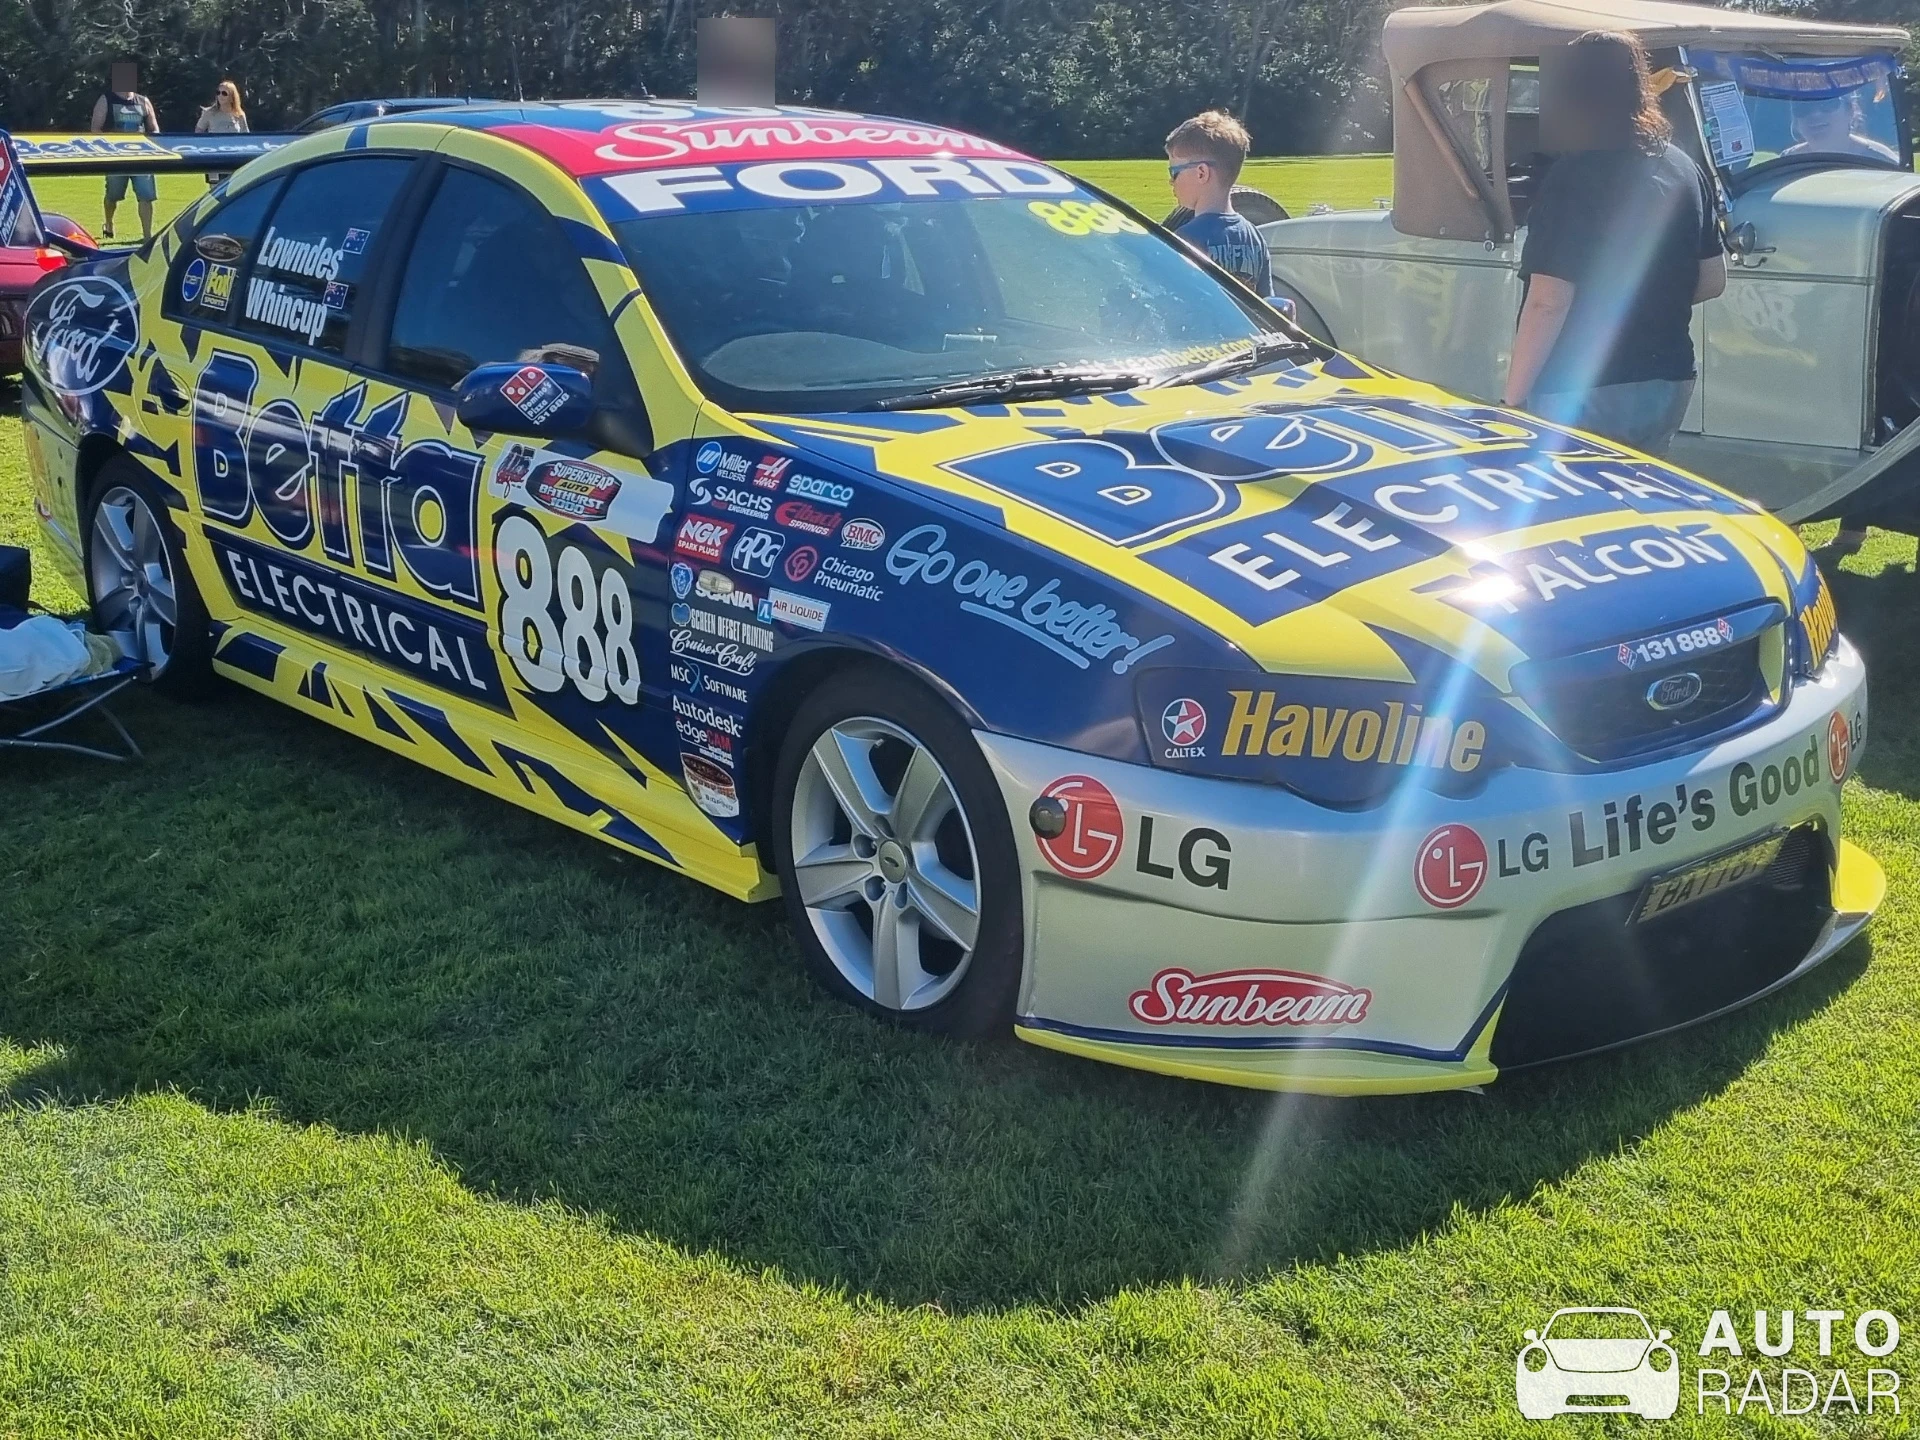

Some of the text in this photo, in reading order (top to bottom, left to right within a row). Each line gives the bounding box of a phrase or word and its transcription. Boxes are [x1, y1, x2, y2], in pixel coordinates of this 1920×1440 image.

[594, 118, 1012, 162] Sunbeam
[602, 158, 1076, 213] FORD
[1027, 200, 1149, 235] 888
[257, 226, 344, 281] Lowndes
[207, 271, 231, 297] FOX
[245, 276, 328, 346] Whincup
[32, 284, 121, 383] Ford
[520, 381, 552, 411] Domino's
[527, 399, 548, 418] Pizza
[533, 392, 570, 425] 131 888
[550, 461, 615, 490] SUPERCHEAP
[716, 469, 747, 483] WELDERS
[718, 451, 752, 474] Miller
[195, 349, 487, 612] Betta
[538, 483, 605, 510] BATHURST
[559, 480, 589, 493] AUTO
[788, 473, 855, 501] sparco
[550, 497, 585, 515] 1000
[713, 485, 773, 512] SACHS
[727, 504, 769, 521] ENGINEERING
[679, 518, 728, 547] NGK
[788, 519, 830, 535] SPRINGS
[846, 524, 881, 545] BMC
[677, 539, 719, 557] SPARK PLUGS
[733, 532, 782, 570] PPG
[821, 556, 874, 583] Chicago
[813, 571, 885, 602] Pneumatic
[886, 524, 1176, 675] Go one better!
[226, 550, 487, 692] ELECTRICAL
[496, 515, 641, 705] 888
[773, 600, 824, 622] AIR LIQUIDE
[690, 608, 774, 653] SCREEN OFFSET PRINTING
[1636, 627, 1721, 662] 131 888
[669, 629, 758, 672] Cruise Craft
[670, 663, 748, 703] MSC SOFTWARE
[1660, 678, 1692, 703] Ford
[672, 694, 741, 738] Autodesk
[1221, 690, 1486, 773] Havoline
[1849, 711, 1863, 750] LG
[1164, 746, 1206, 759] CALTEX
[1497, 734, 1821, 880] LG Life's Good
[1135, 815, 1233, 891] LG
[1133, 972, 1369, 1023] Sunbeam
